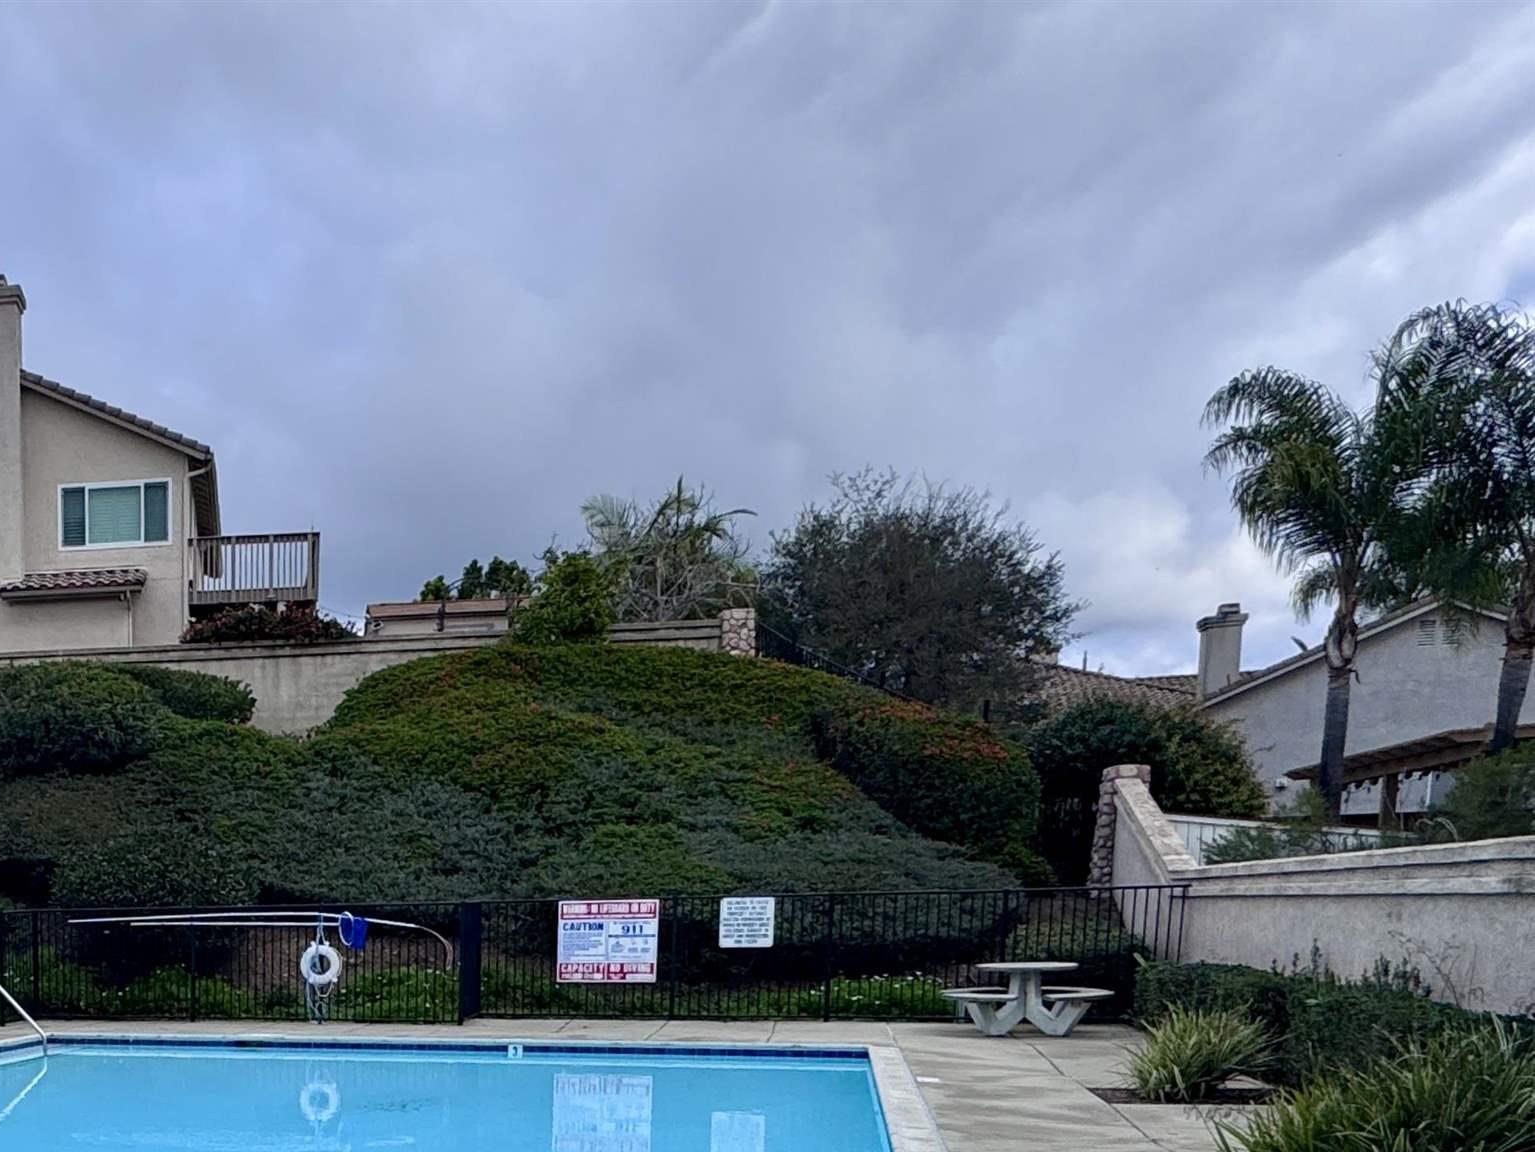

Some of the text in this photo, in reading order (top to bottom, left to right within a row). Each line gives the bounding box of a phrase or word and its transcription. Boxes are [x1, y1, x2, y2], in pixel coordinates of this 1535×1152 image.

[562, 921, 604, 931] CAUTION
[621, 924, 644, 934] 911
[561, 962, 604, 973] CAPACITY
